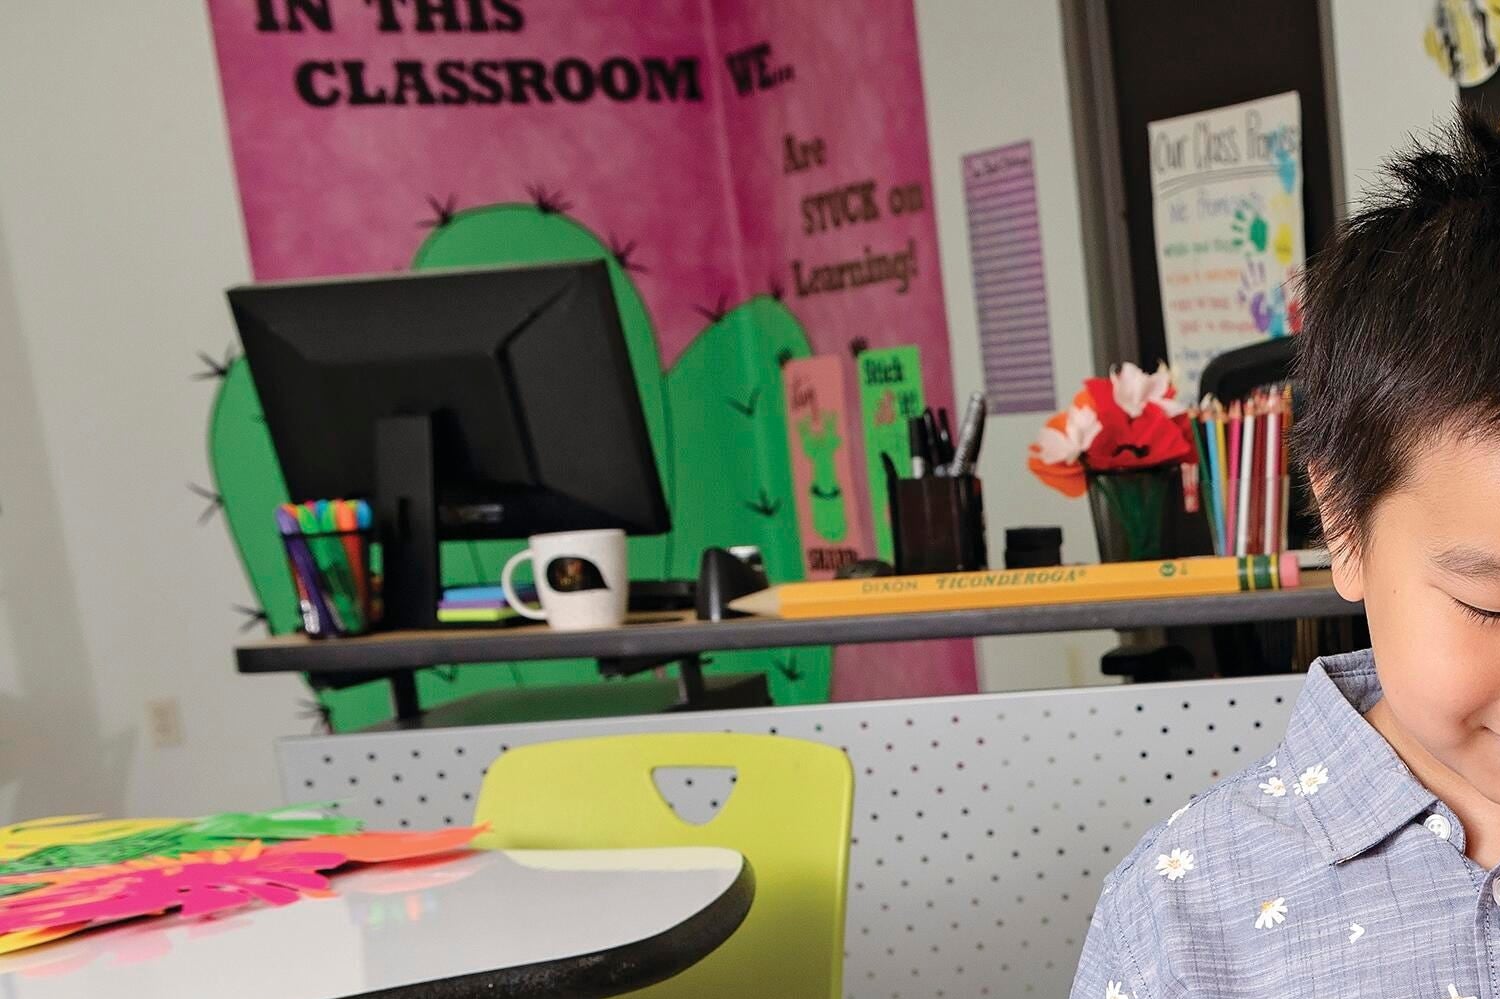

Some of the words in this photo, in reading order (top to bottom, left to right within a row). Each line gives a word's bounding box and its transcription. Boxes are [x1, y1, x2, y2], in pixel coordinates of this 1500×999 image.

[255, 0, 334, 33] IN
[366, 0, 525, 33] THIS
[294, 57, 702, 107] CLASSROOM
[784, 133, 827, 175] Are
[801, 180, 880, 236] STUCK
[888, 182, 925, 217] on
[791, 239, 919, 298] Learning!
[862, 580, 919, 594] DIXON
